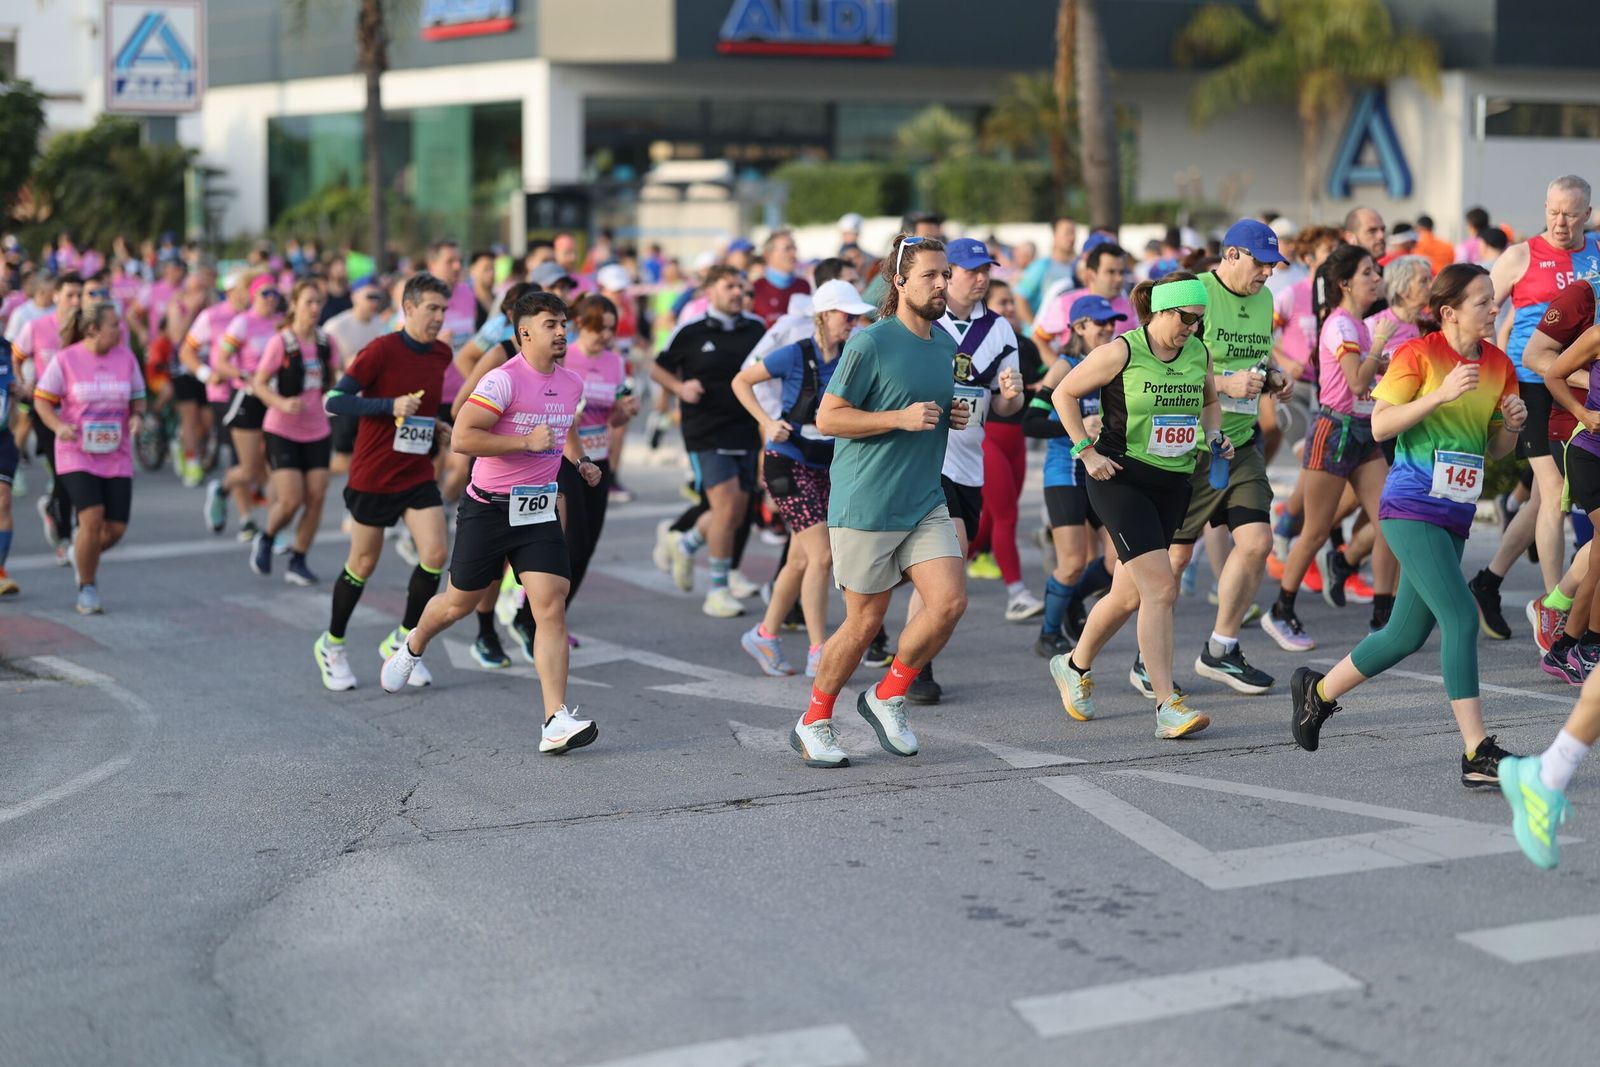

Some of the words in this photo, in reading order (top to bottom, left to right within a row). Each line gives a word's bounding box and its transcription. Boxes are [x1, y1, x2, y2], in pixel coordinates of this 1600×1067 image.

[718, 0, 898, 44] ALDI
[1216, 328, 1271, 345] Porterstown
[1226, 344, 1269, 359] Panthers
[1143, 381, 1203, 394] Porterstown
[544, 403, 565, 413] XXXVI
[1154, 395, 1200, 407] Panthers
[512, 411, 547, 425] MEDIA
[1155, 427, 1195, 444] 1680
[1446, 465, 1478, 488] 145
[518, 494, 549, 512] 760
